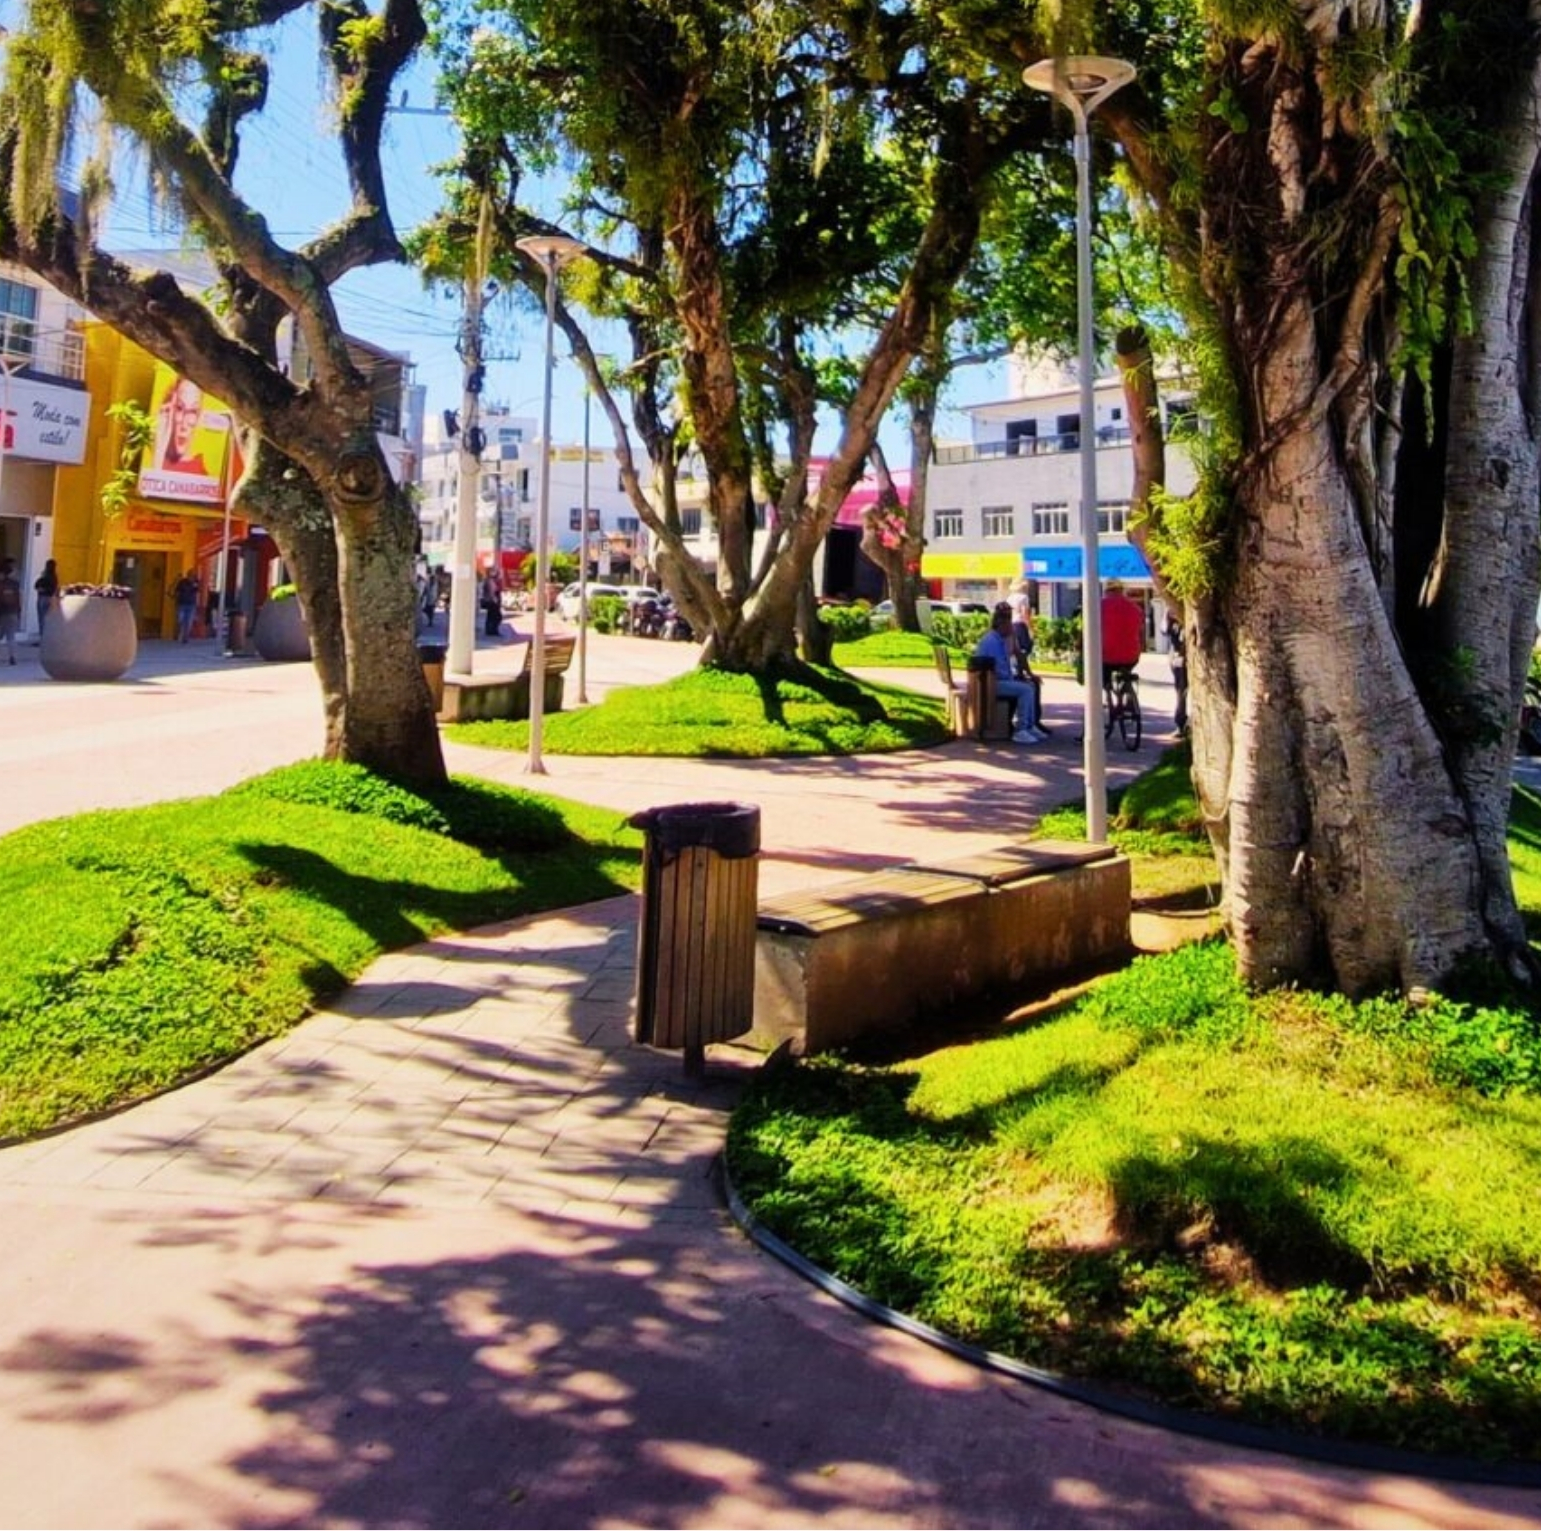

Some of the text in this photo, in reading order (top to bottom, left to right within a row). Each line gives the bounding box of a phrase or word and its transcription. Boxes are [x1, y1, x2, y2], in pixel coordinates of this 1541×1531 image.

[33, 400, 80, 427] Moda com
[39, 428, 70, 446] estilo!
